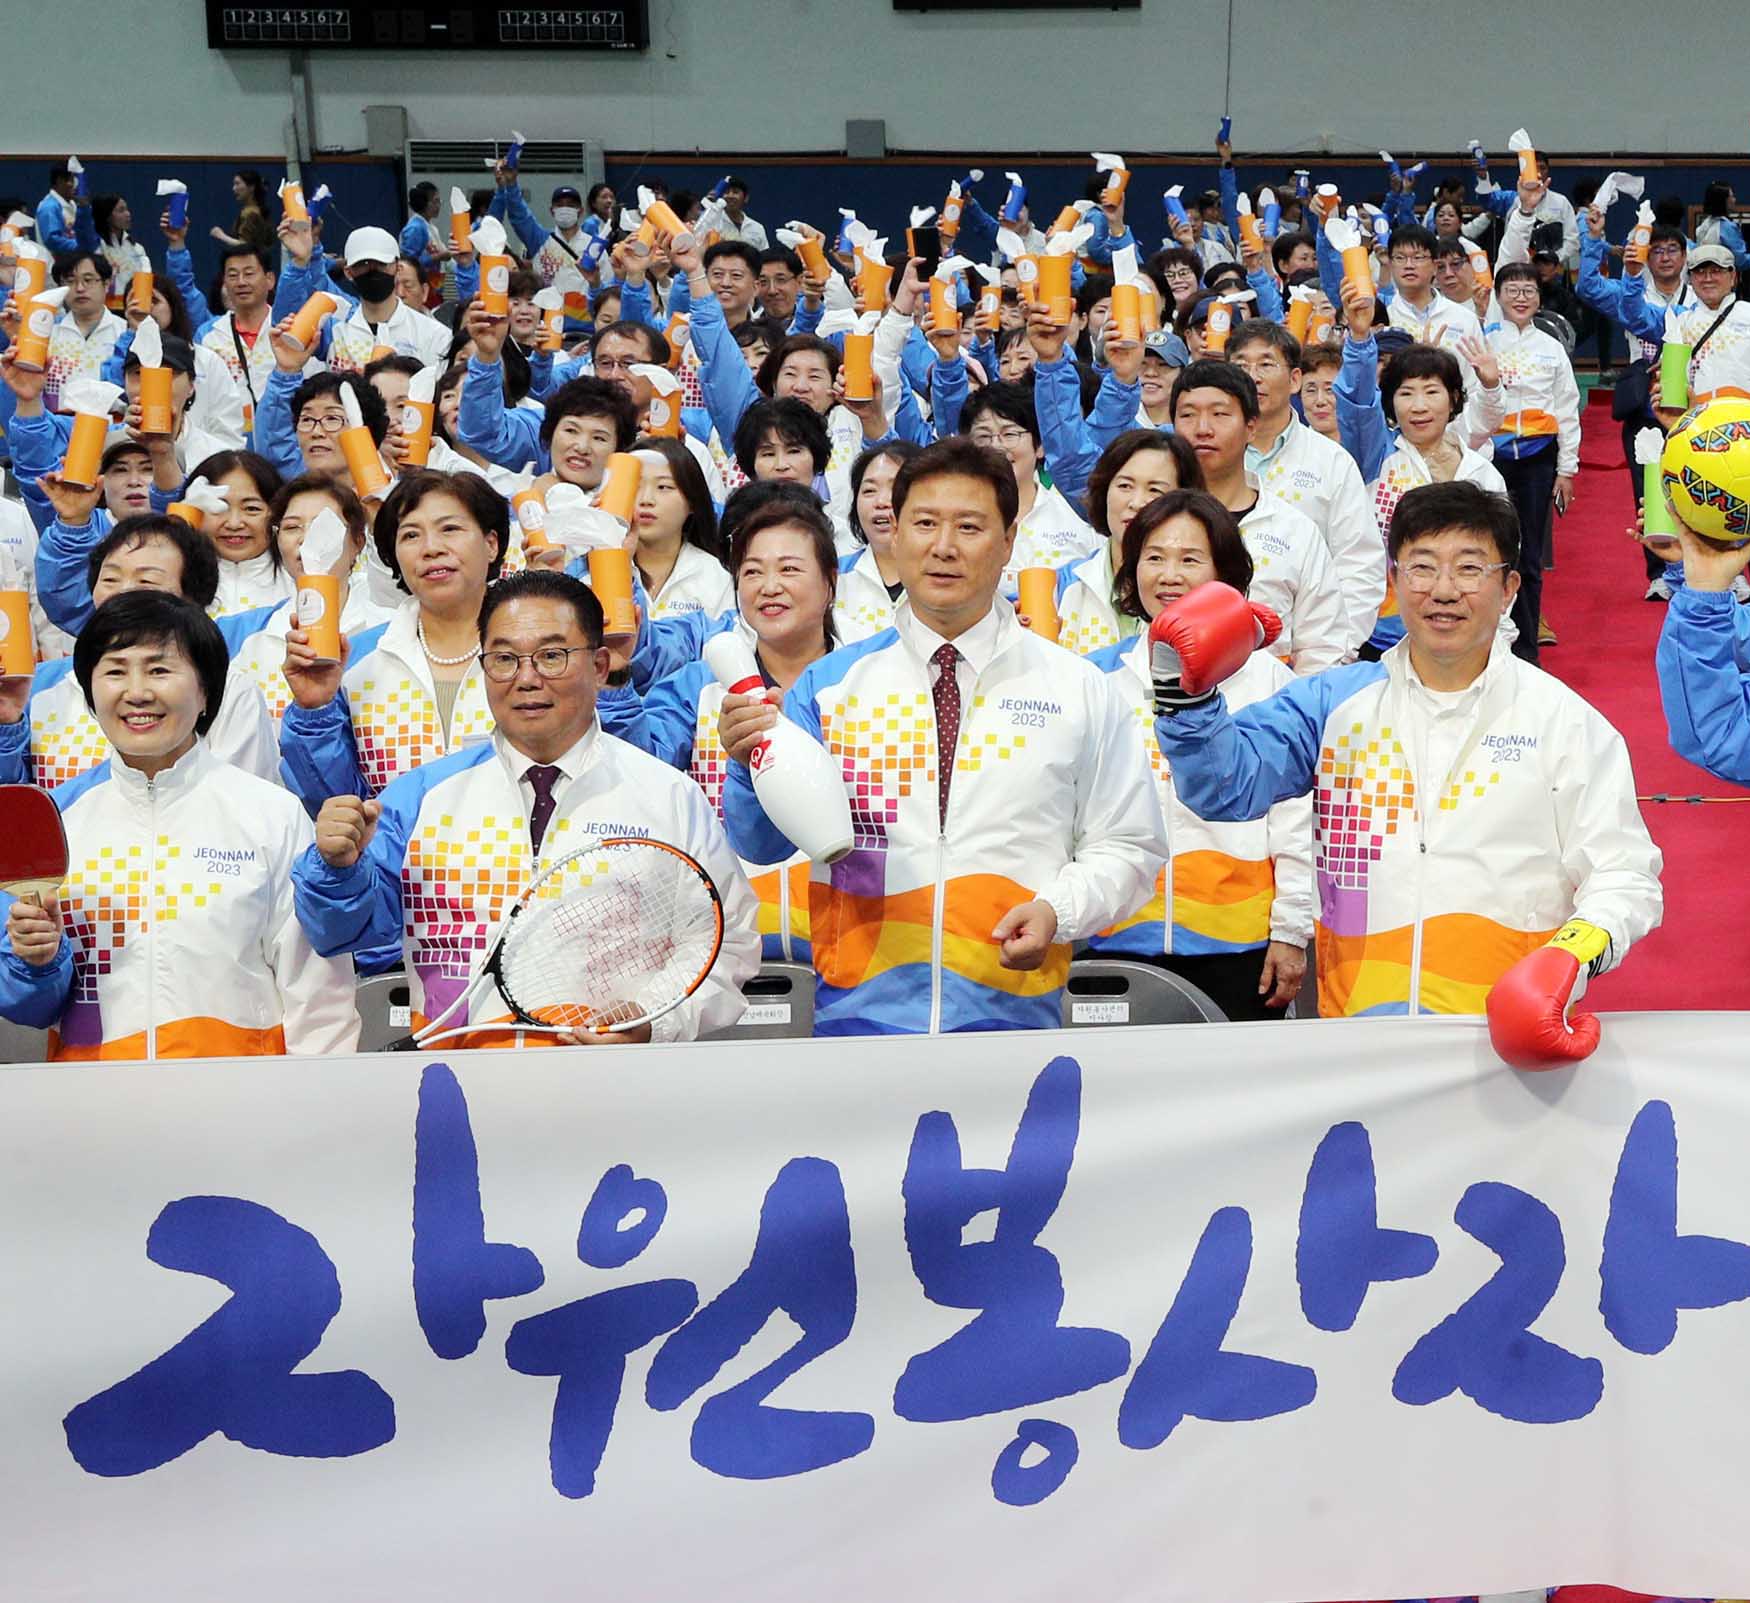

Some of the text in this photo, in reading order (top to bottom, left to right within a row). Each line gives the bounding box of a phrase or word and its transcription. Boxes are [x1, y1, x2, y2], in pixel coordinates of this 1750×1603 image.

[1291, 470, 1322, 484] JONNAM
[998, 698, 1062, 715] JEONNAM
[1011, 713, 1046, 728] 2023
[583, 822, 650, 838] JEONNAM
[193, 847, 256, 862] JEONNAM
[207, 860, 241, 876] 2023
